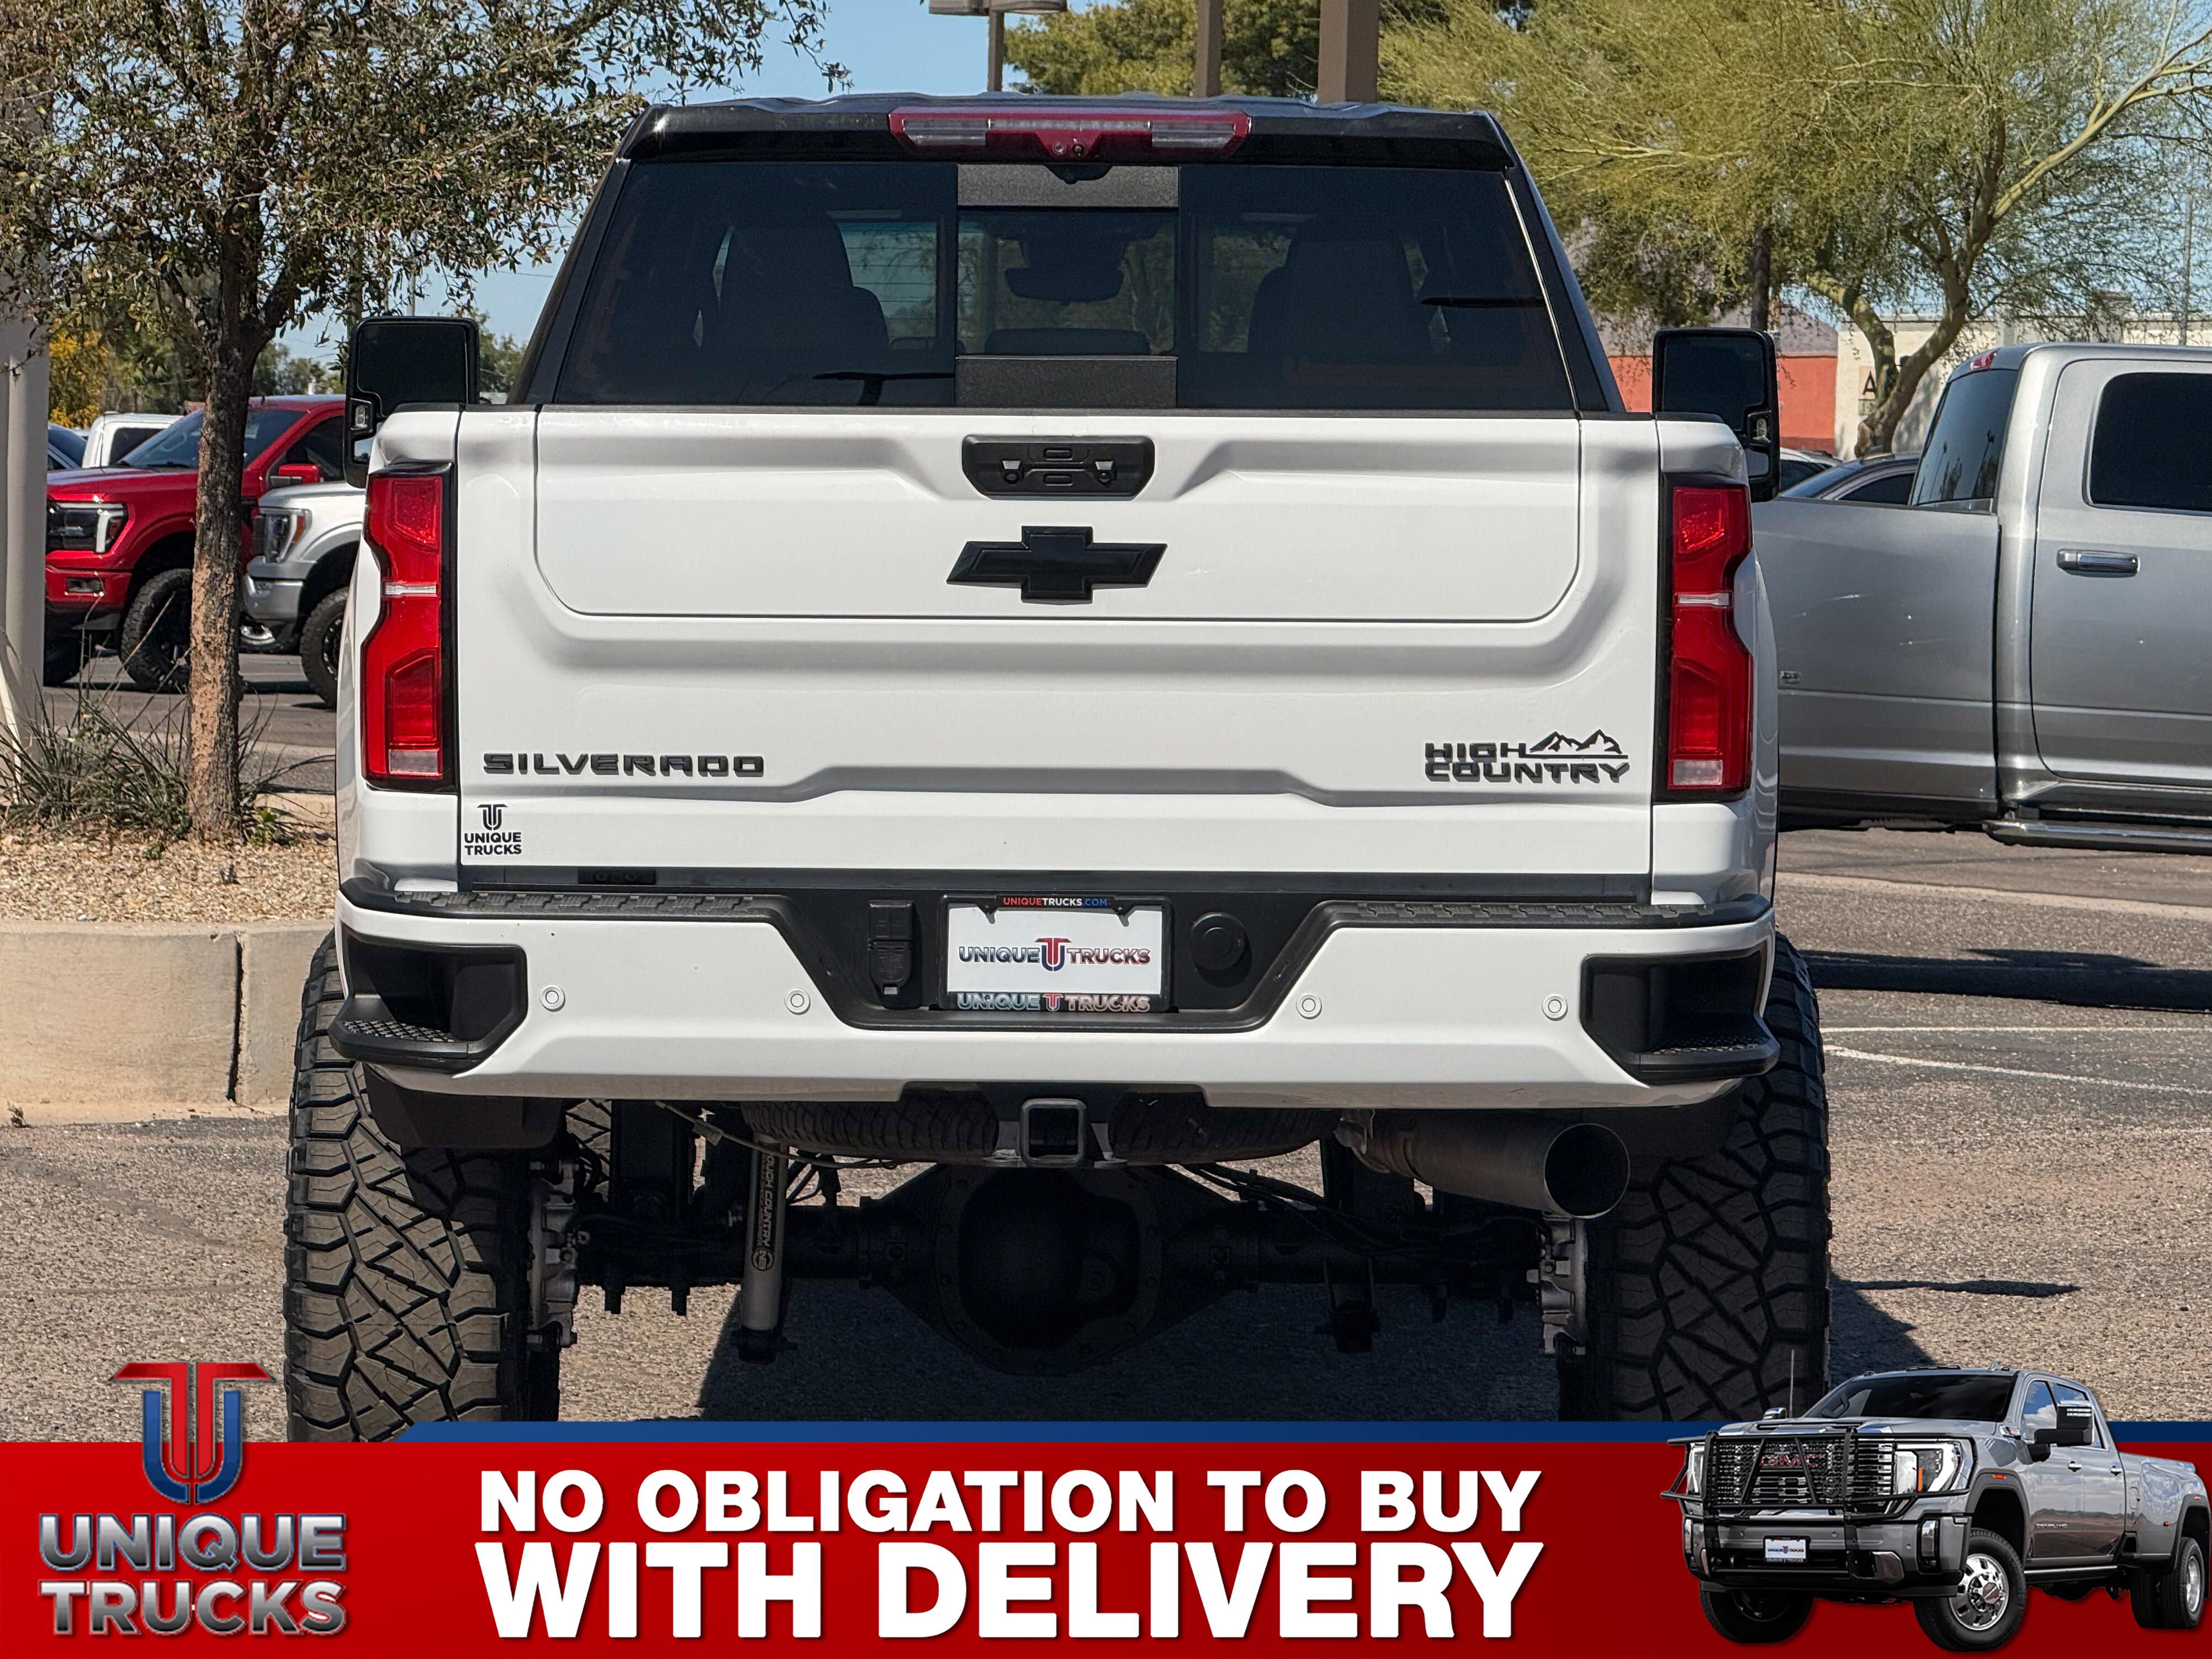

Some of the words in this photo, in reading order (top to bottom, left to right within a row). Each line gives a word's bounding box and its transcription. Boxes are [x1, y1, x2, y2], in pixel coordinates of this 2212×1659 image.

[1425, 742, 1526, 762] HIGH
[483, 753, 764, 777] SILVERADO
[1425, 762, 1630, 783] COUNTRY
[464, 832, 522, 843] UNIQUE
[464, 844, 522, 855] TRUCKS
[1003, 897, 1108, 906] UNIQUETRUCKS.COM
[959, 946, 1040, 963] UNIQUE
[1067, 948, 1151, 965] TRUCKS
[957, 992, 1041, 1011] UNIQUE
[1065, 995, 1151, 1013] TRUCKS
[765, 1154, 774, 1188] OUGH
[763, 1190, 773, 1246] COUNTRY
